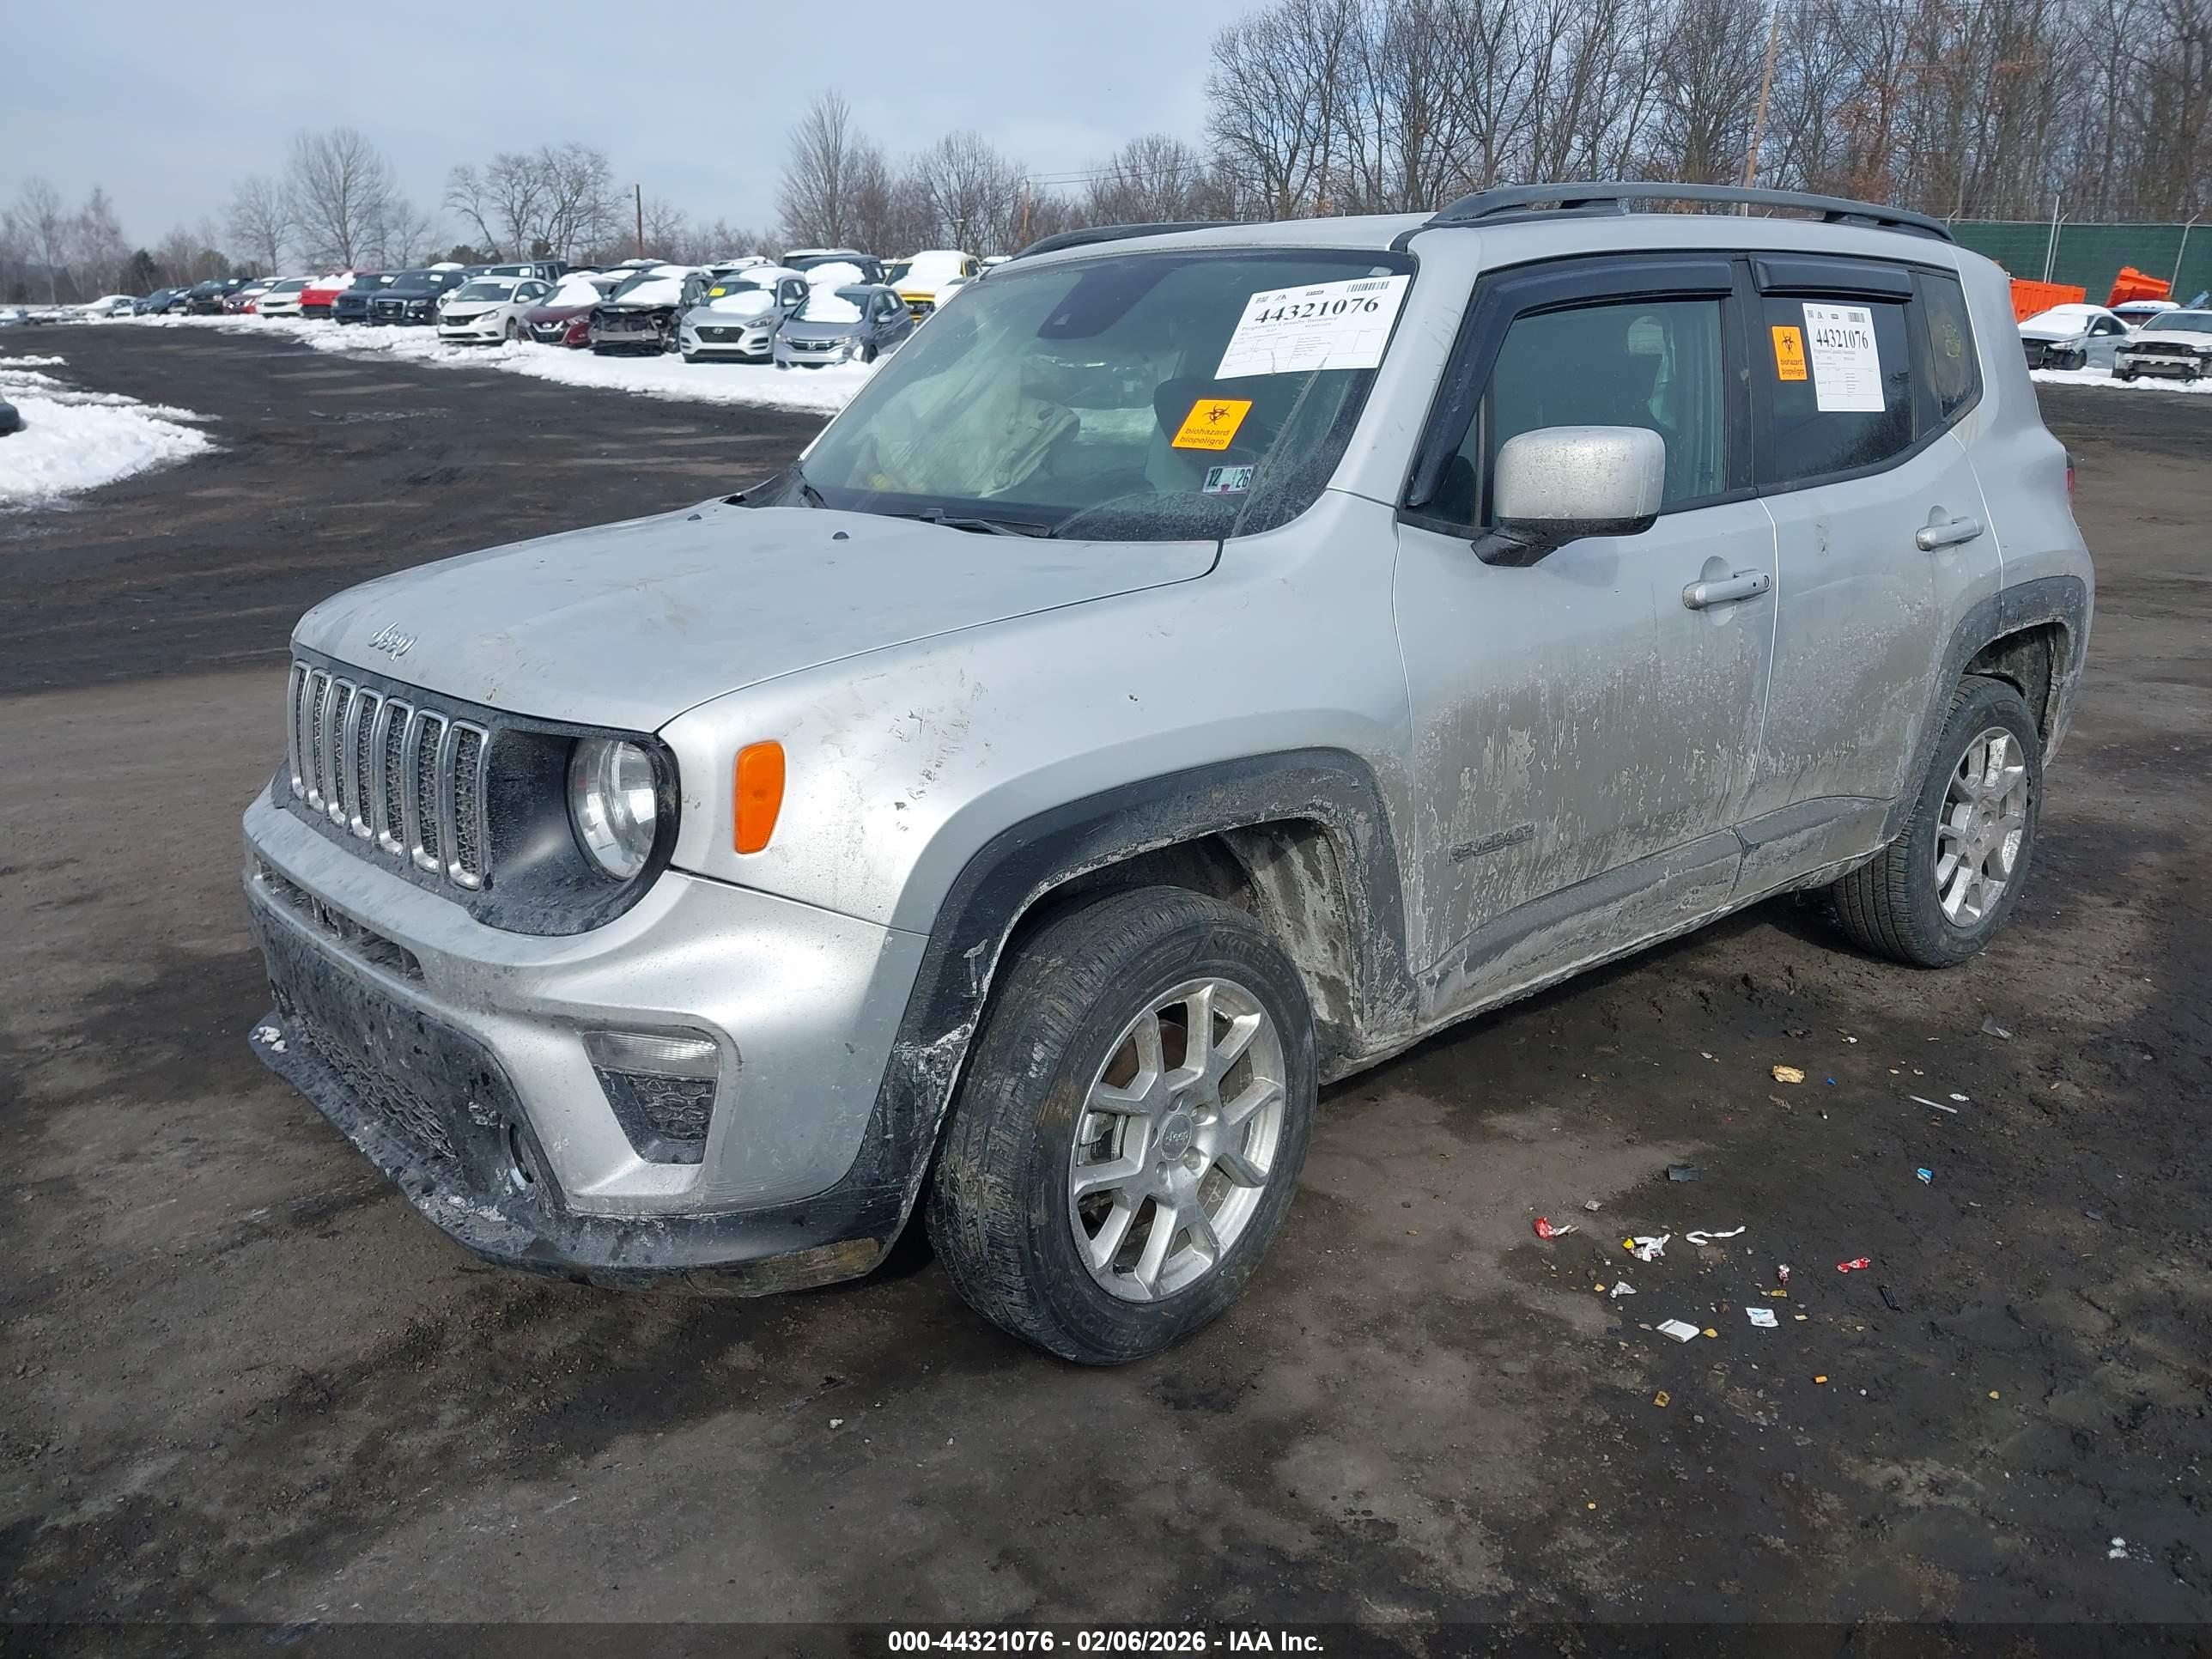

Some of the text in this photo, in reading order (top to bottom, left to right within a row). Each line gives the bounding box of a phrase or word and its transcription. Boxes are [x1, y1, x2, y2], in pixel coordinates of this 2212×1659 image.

[1255, 296, 1382, 324] 44321076
[1816, 328, 1869, 349] 44321076
[1180, 436, 1224, 446] biopeligro
[1185, 428, 1230, 436] biohazard
[1207, 468, 1251, 489] 12 26
[368, 622, 417, 661] Jeep
